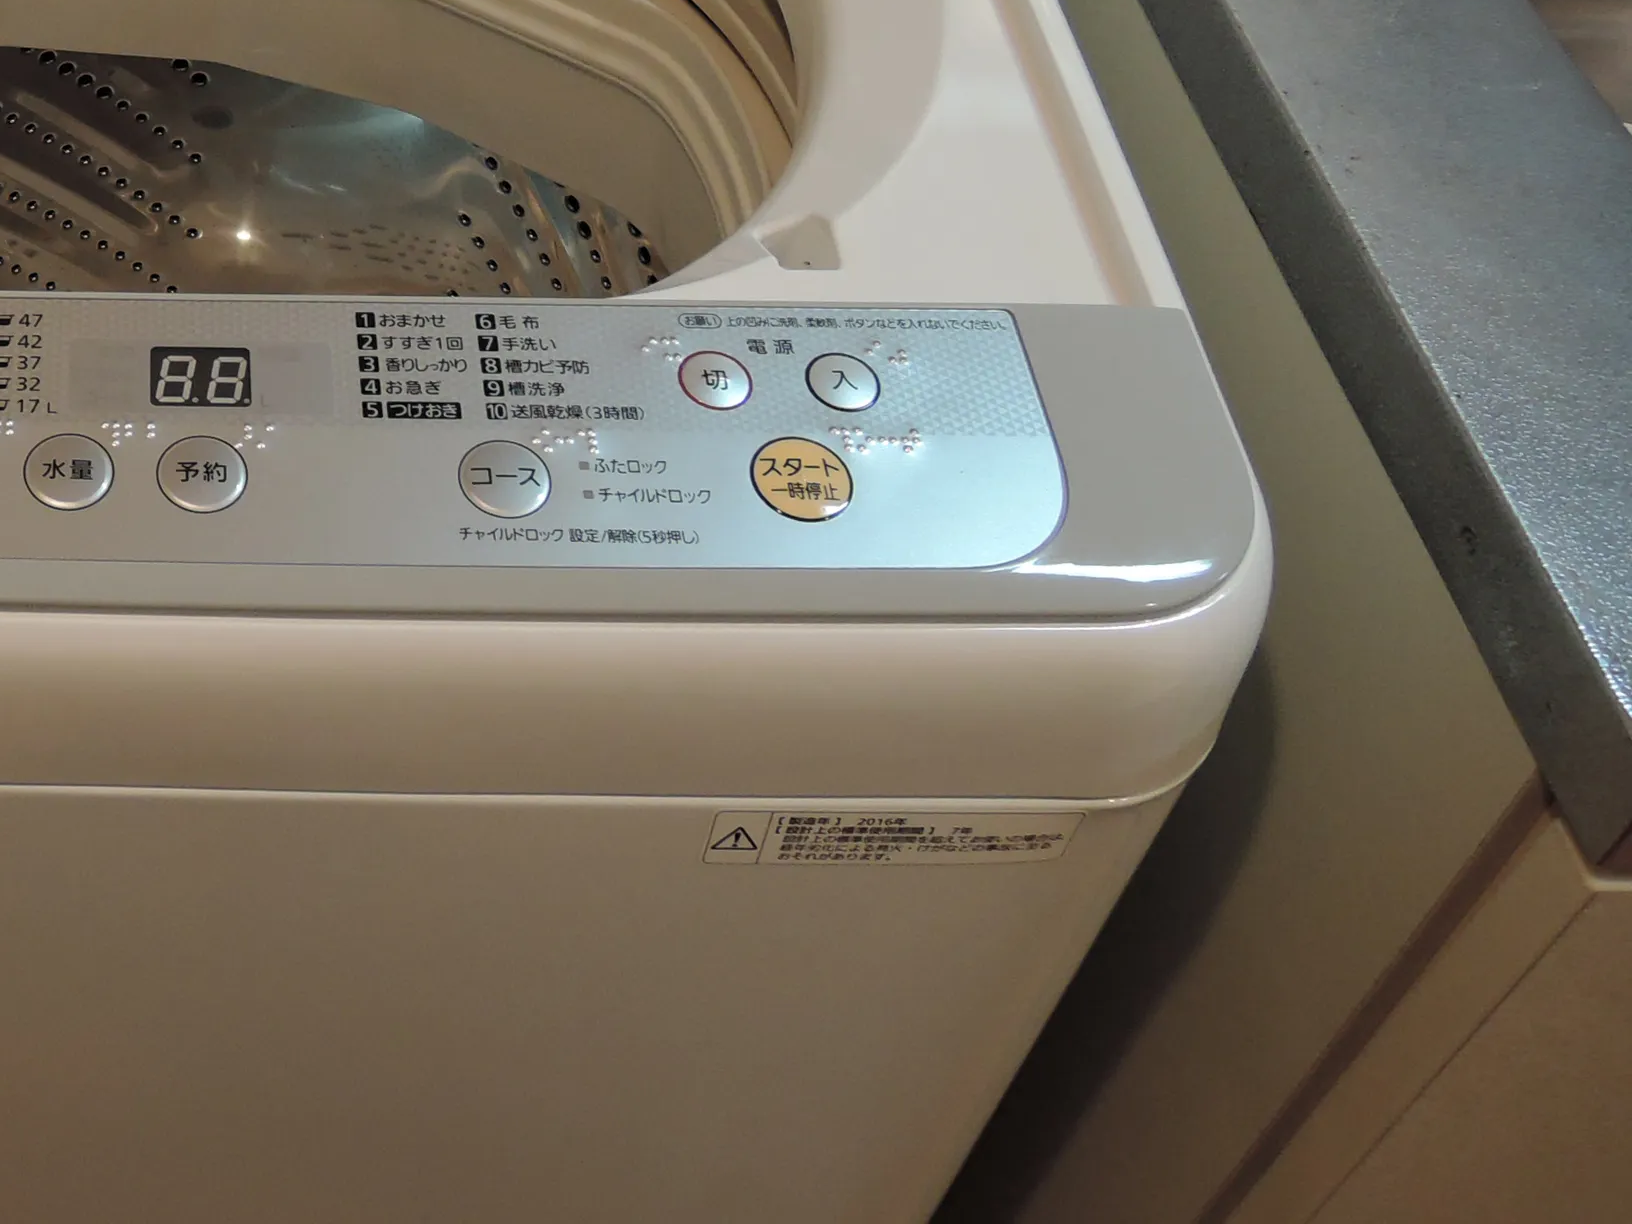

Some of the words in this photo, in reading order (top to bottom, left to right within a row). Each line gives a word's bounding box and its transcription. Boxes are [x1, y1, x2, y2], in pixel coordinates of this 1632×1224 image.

[18, 313, 43, 327] 47
[379, 314, 446, 328] おまかせ
[499, 315, 540, 330] 毛布
[17, 334, 43, 349] 42
[381, 336, 464, 351] すすぎ1回
[502, 337, 557, 352] 手洗い
[746, 338, 795, 355] 電源
[16, 355, 42, 370] 37
[386, 358, 468, 373] 香りしっかり
[505, 359, 590, 375] 槽カビ予防
[16, 377, 42, 391] 32
[701, 368, 729, 391] 切
[831, 369, 859, 390] 入
[386, 381, 442, 395] お急ぎ
[508, 382, 566, 397] 槽洗浄
[16, 399, 41, 414] 17
[388, 403, 460, 418] つけおき
[510, 405, 645, 421] 送風乾燥(3時間)
[42, 458, 94, 480] 水量
[175, 461, 228, 483] 予約
[594, 458, 667, 474] ふたロック
[759, 457, 840, 478] スタート
[470, 466, 541, 487] コース
[598, 488, 711, 504] チャイルドロック
[770, 481, 841, 501] 一時停止
[459, 527, 564, 542] チャイルドロック
[569, 528, 700, 546] 設定/解除(5秒押し)
